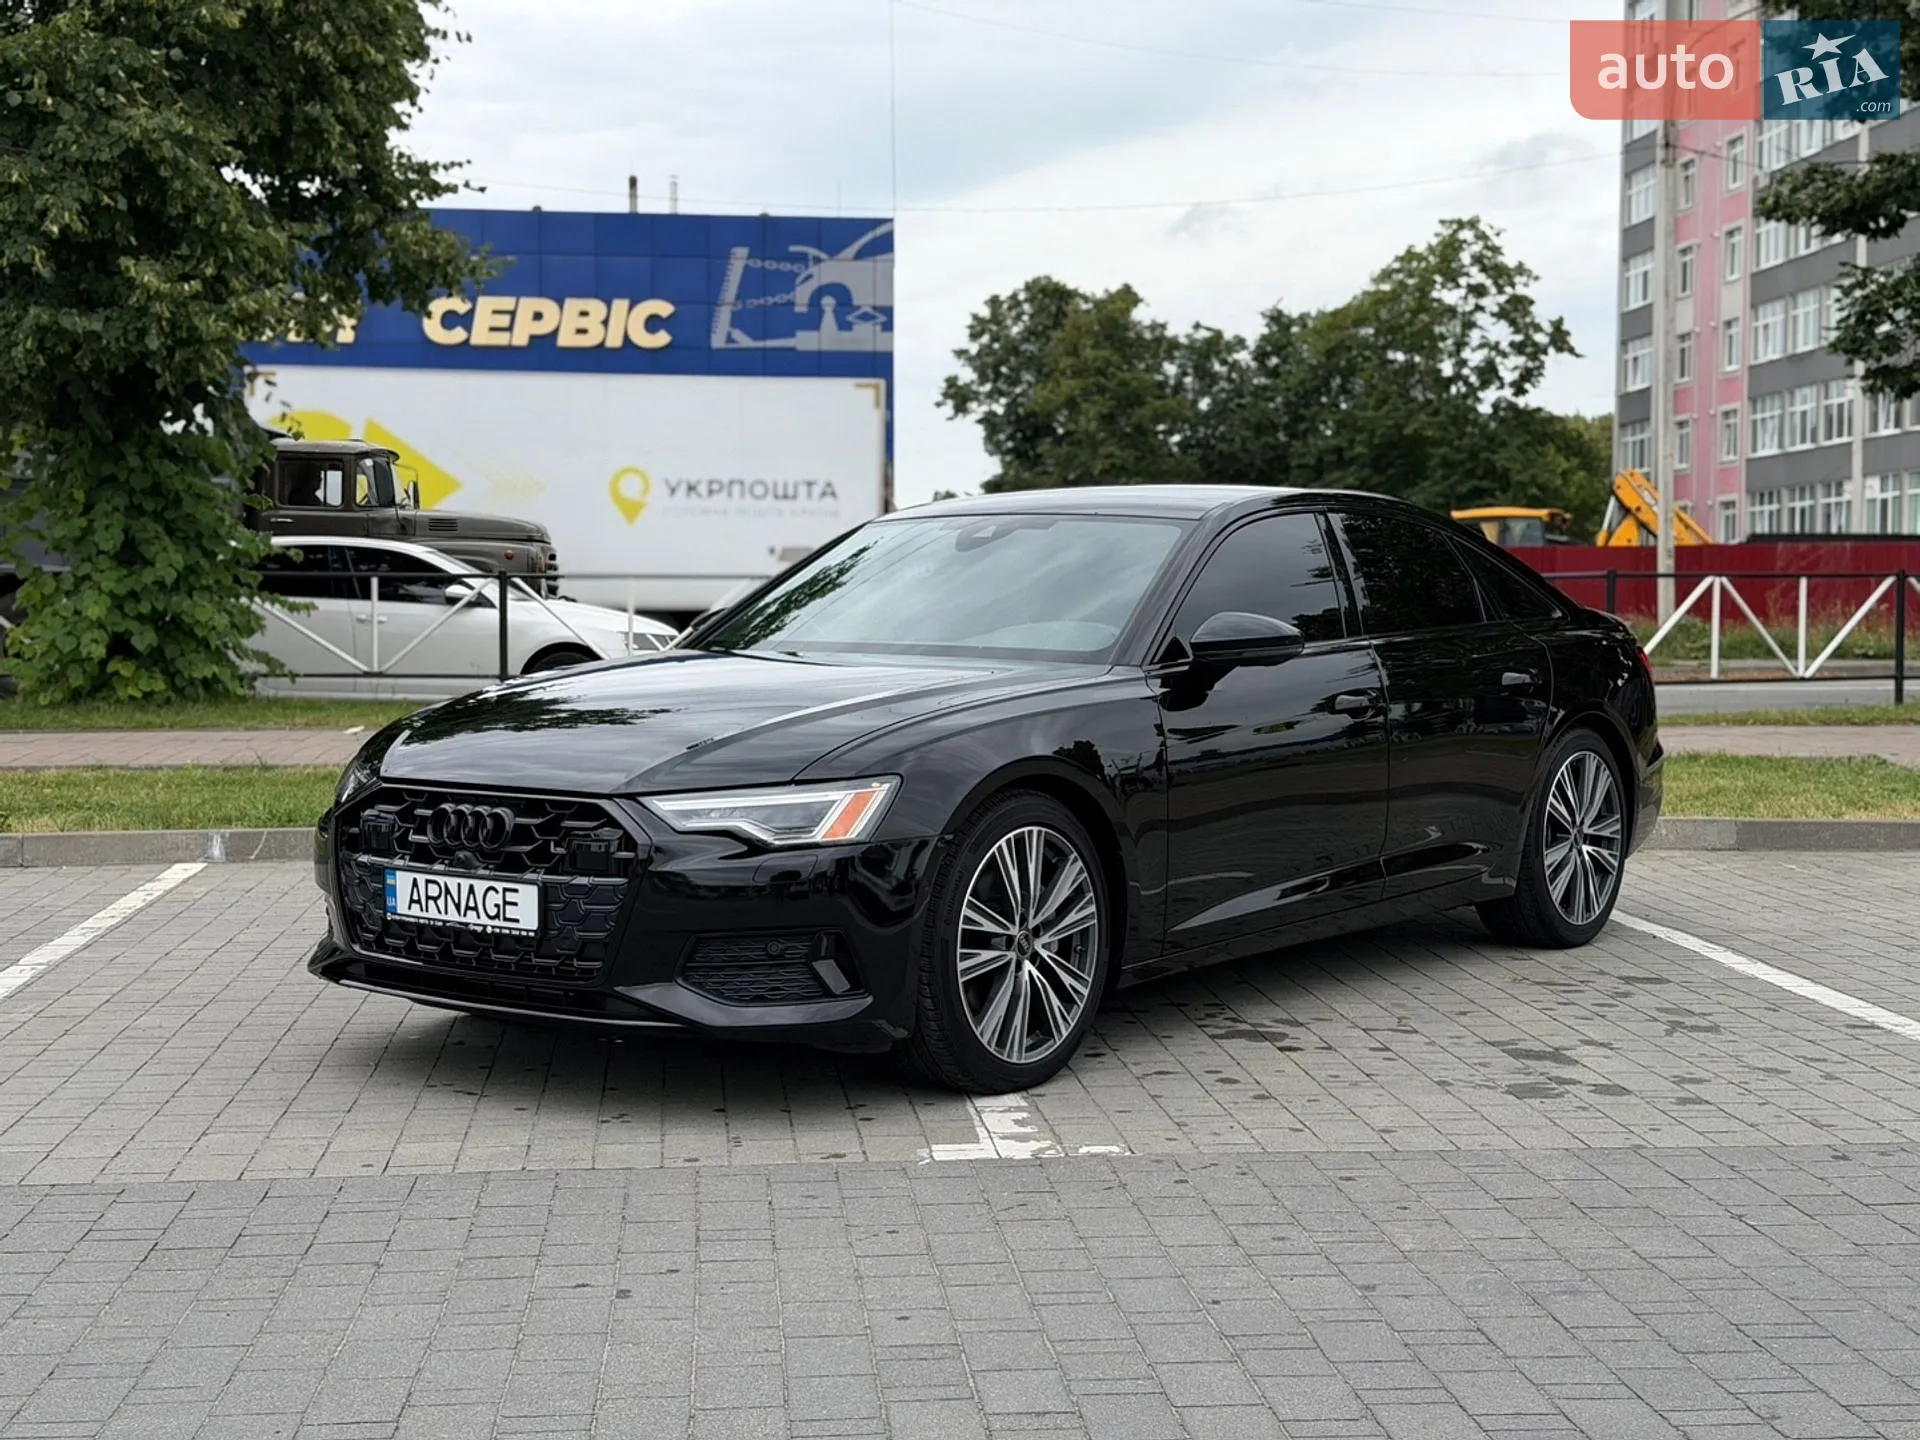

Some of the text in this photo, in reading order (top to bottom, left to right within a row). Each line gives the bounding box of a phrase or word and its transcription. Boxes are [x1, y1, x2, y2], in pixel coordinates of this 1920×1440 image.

[422, 296, 676, 349] СЕРВІС
[664, 478, 839, 501] УКРПОШТА
[408, 877, 520, 924] ARNAGE
